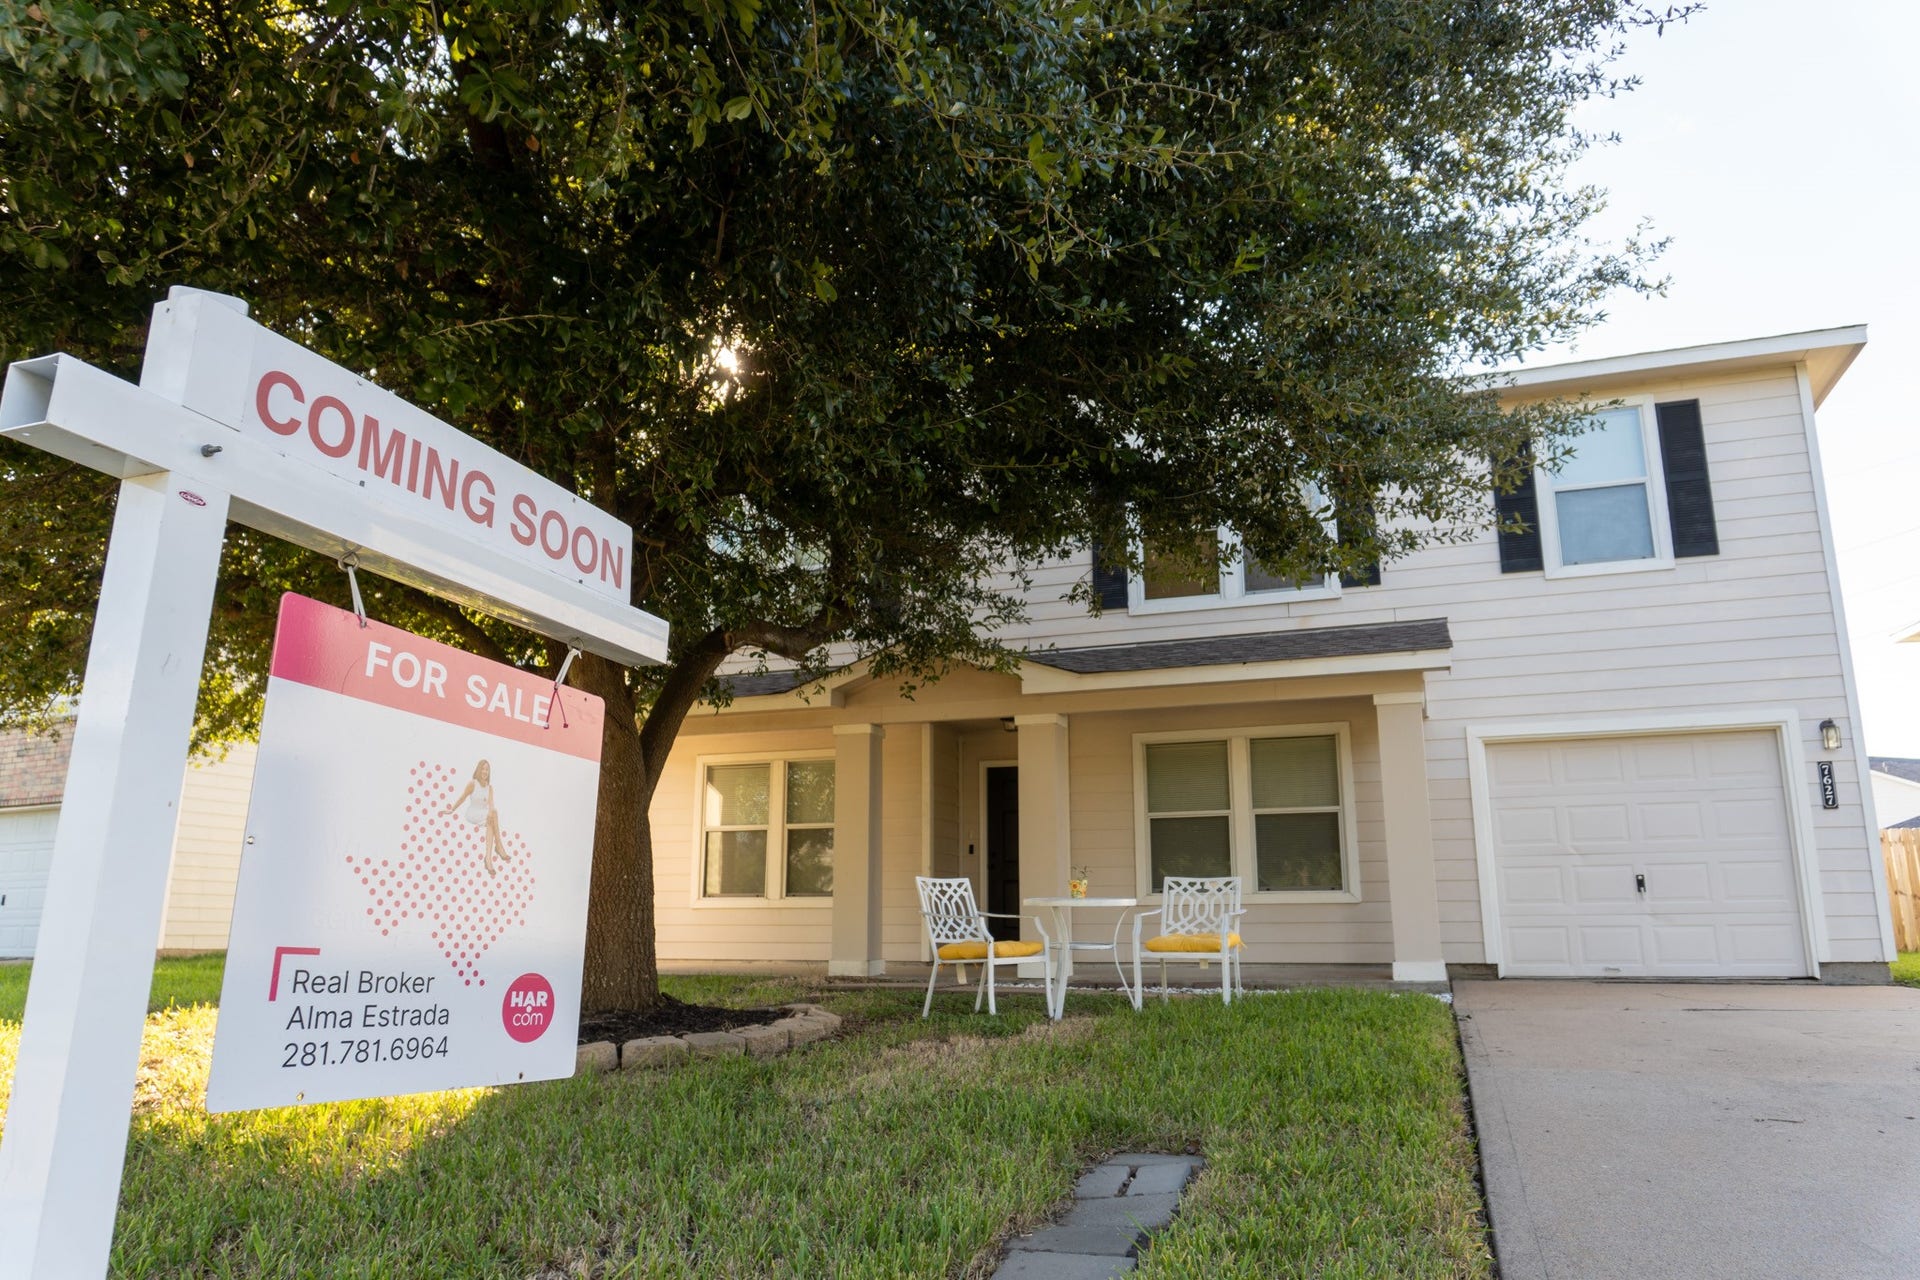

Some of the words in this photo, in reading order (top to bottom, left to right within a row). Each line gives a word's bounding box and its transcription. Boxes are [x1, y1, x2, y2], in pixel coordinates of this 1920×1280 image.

[256, 371, 496, 529] COMING
[510, 493, 624, 589] SOON
[365, 641, 448, 698] FOR
[465, 674, 551, 728] SALE
[1822, 765, 1834, 805] 7627
[292, 969, 349, 994] Real
[357, 970, 435, 994] Broker
[510, 990, 548, 1008] HAR
[286, 1005, 352, 1030] Alma
[362, 1003, 450, 1028] Estrada
[282, 1036, 449, 1068] 281.781.6964
